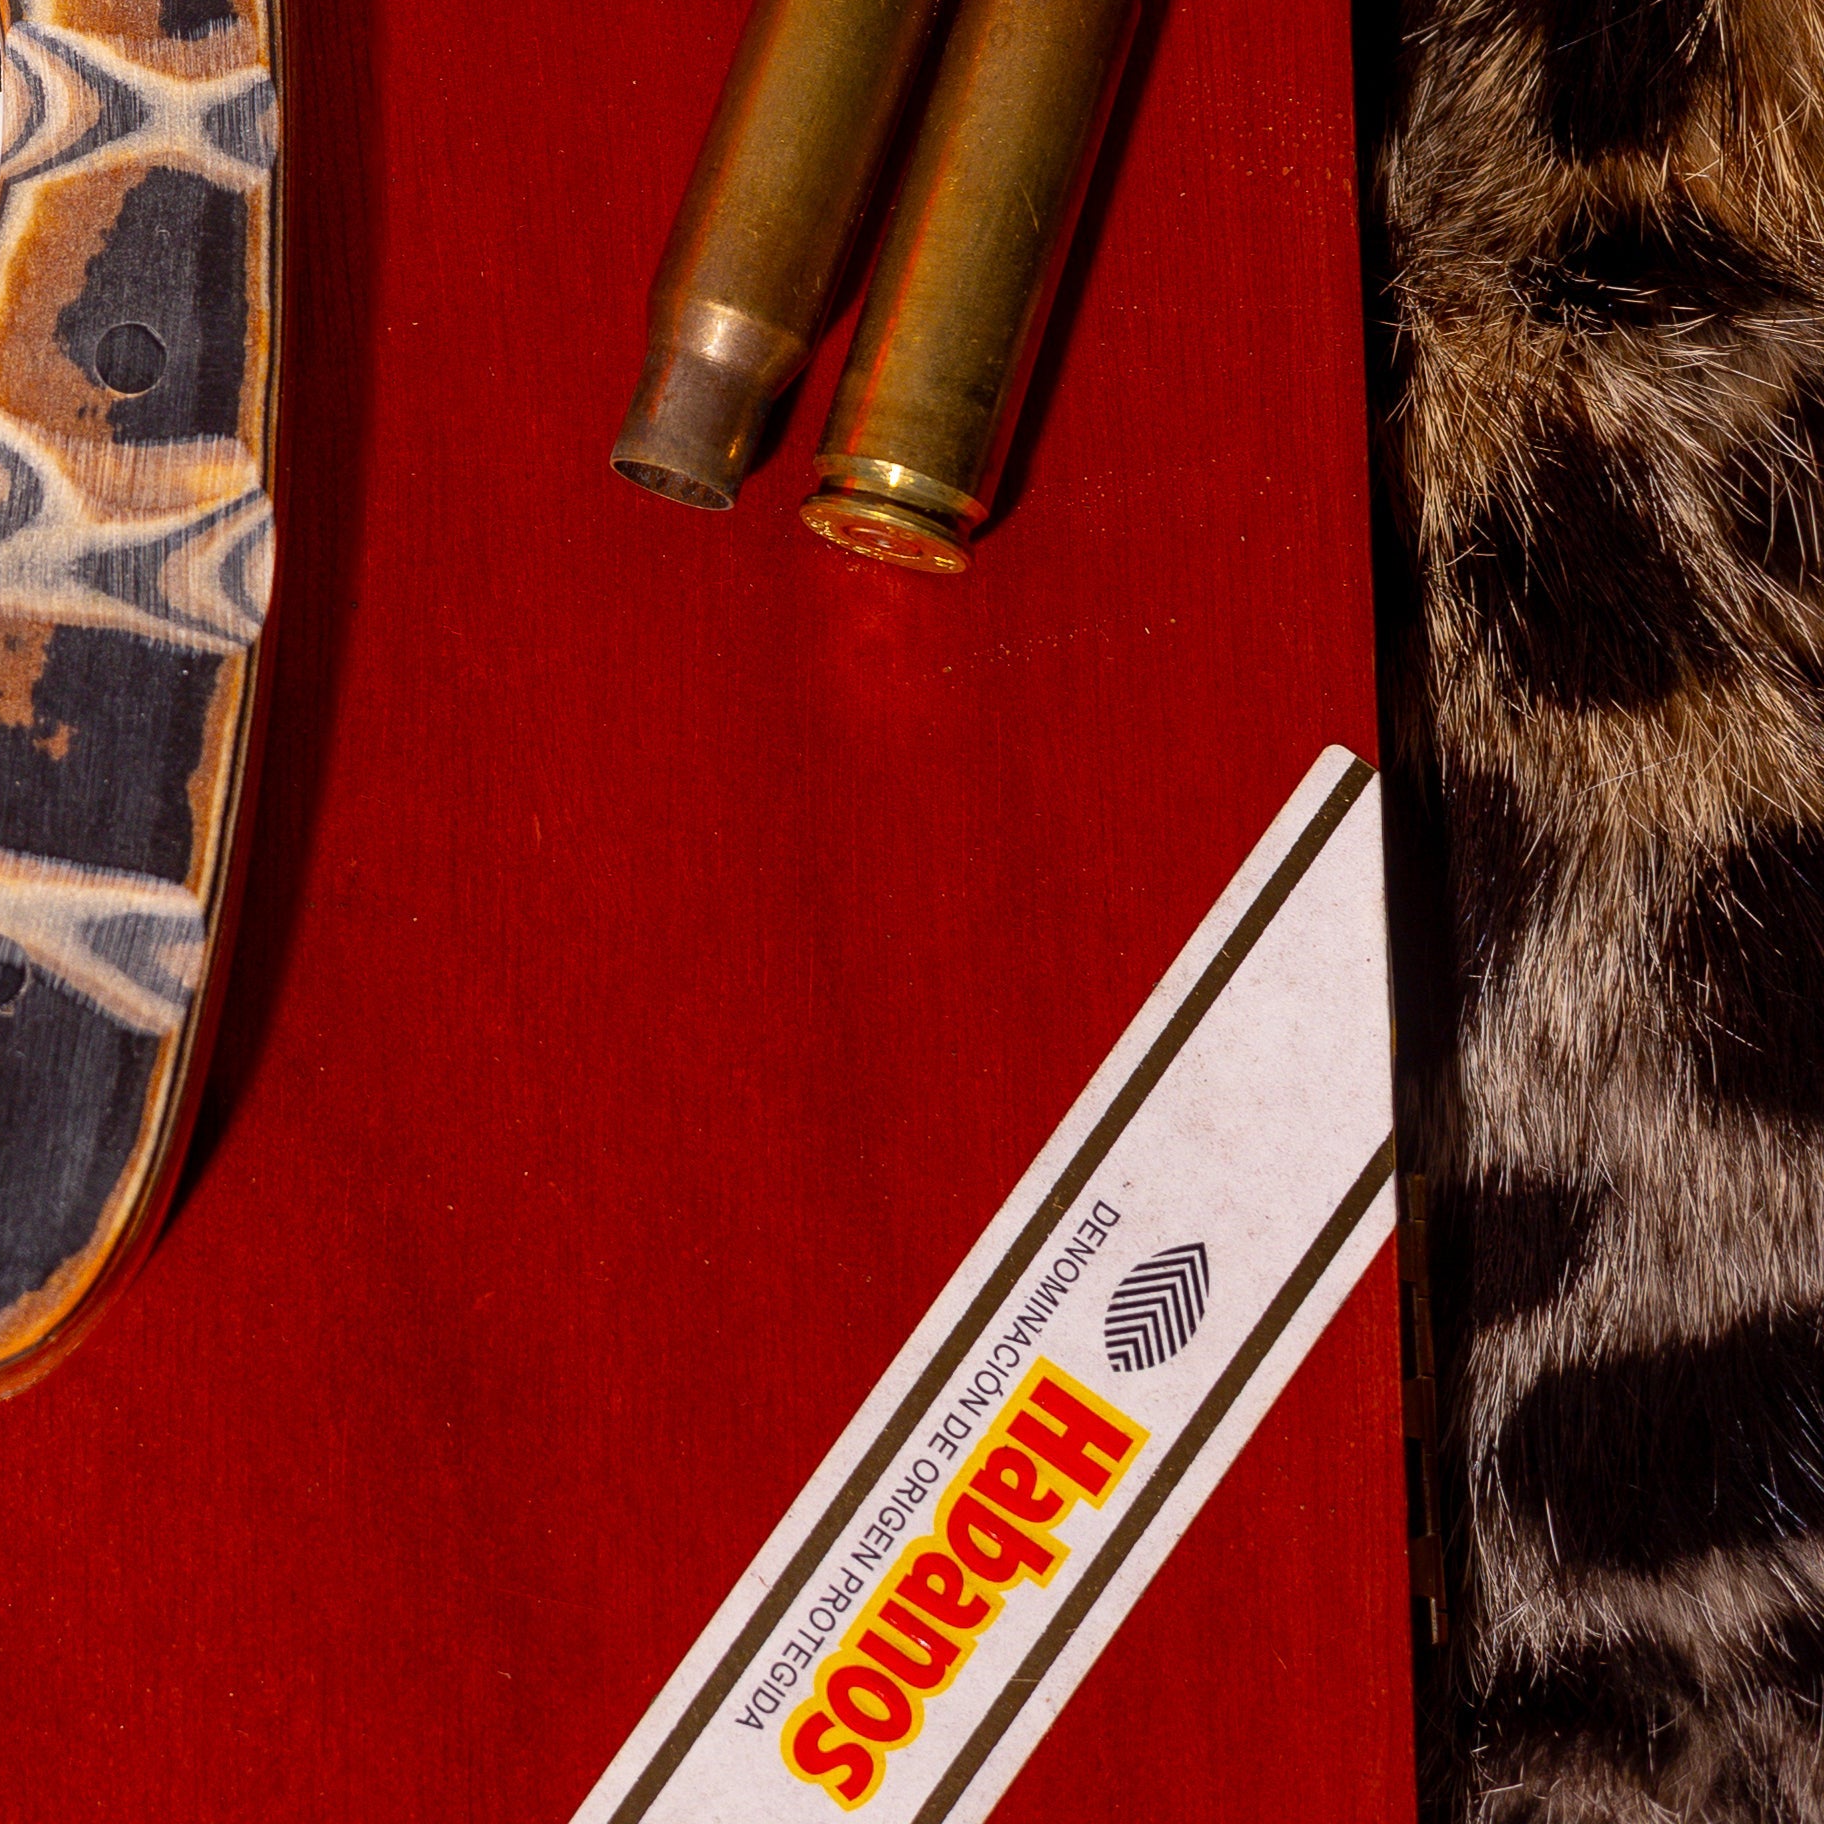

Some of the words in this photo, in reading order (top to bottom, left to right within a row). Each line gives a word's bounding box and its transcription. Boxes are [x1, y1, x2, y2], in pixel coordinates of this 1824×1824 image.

[957, 1199, 1122, 1418] DENOMINACIÓN
[850, 1457, 941, 1572] ORIGEN
[927, 1412, 972, 1462] DE
[734, 1566, 865, 1731] PROTEGIDA
[786, 1366, 1143, 1808] Habanos
